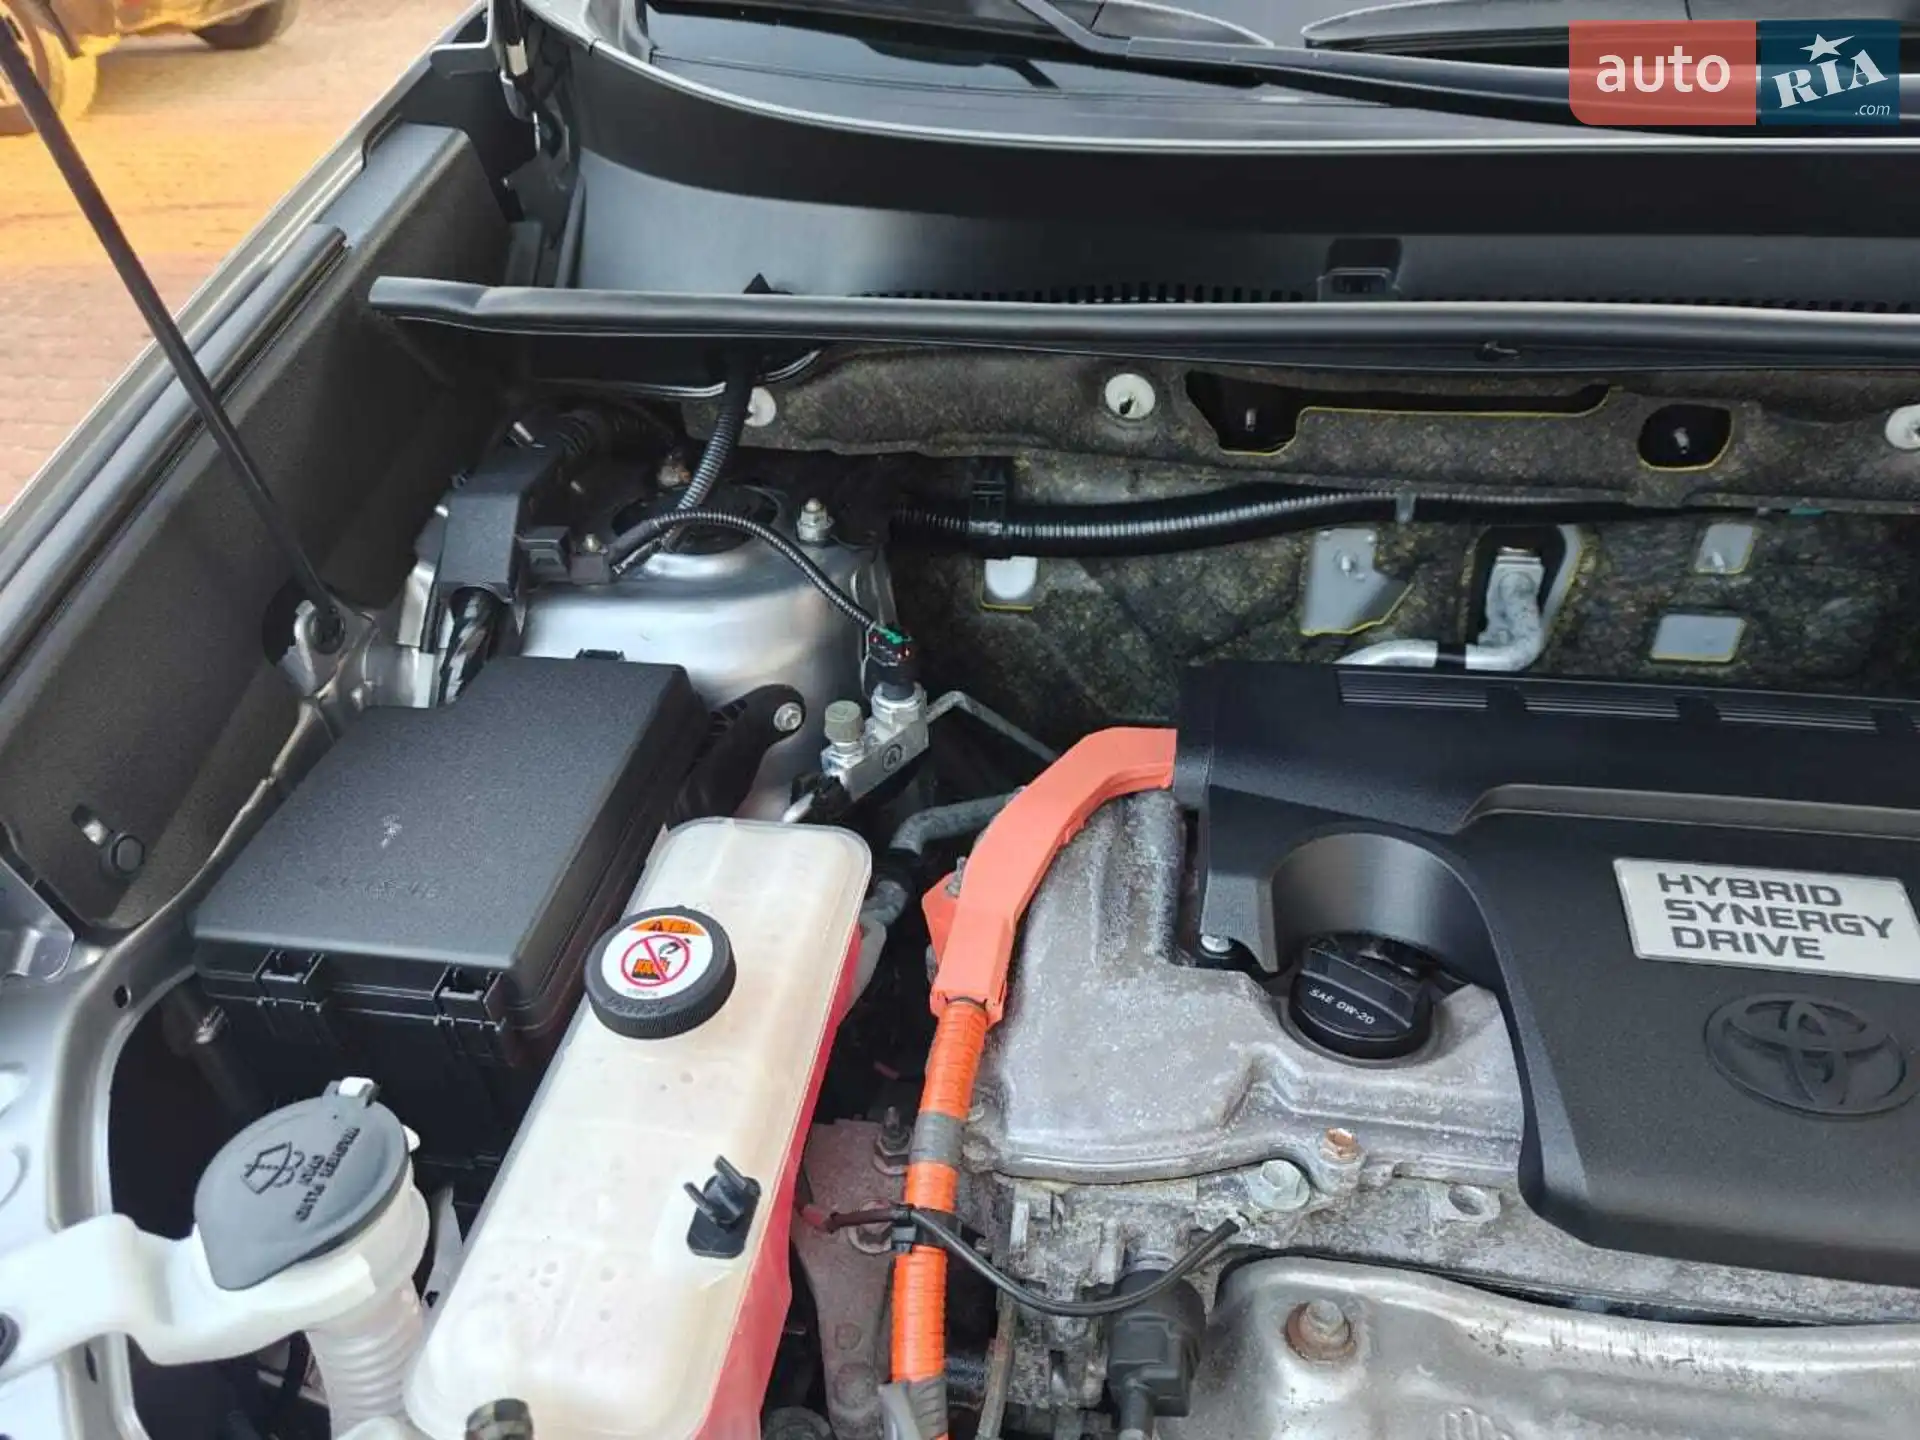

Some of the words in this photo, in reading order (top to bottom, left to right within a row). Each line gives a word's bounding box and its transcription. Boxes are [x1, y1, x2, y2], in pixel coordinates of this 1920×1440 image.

[1657, 872, 1843, 907] HYBRID
[1664, 898, 1893, 938] SYNERGY
[1672, 926, 1825, 961] DRIVE
[1308, 988, 1335, 1005] SAE
